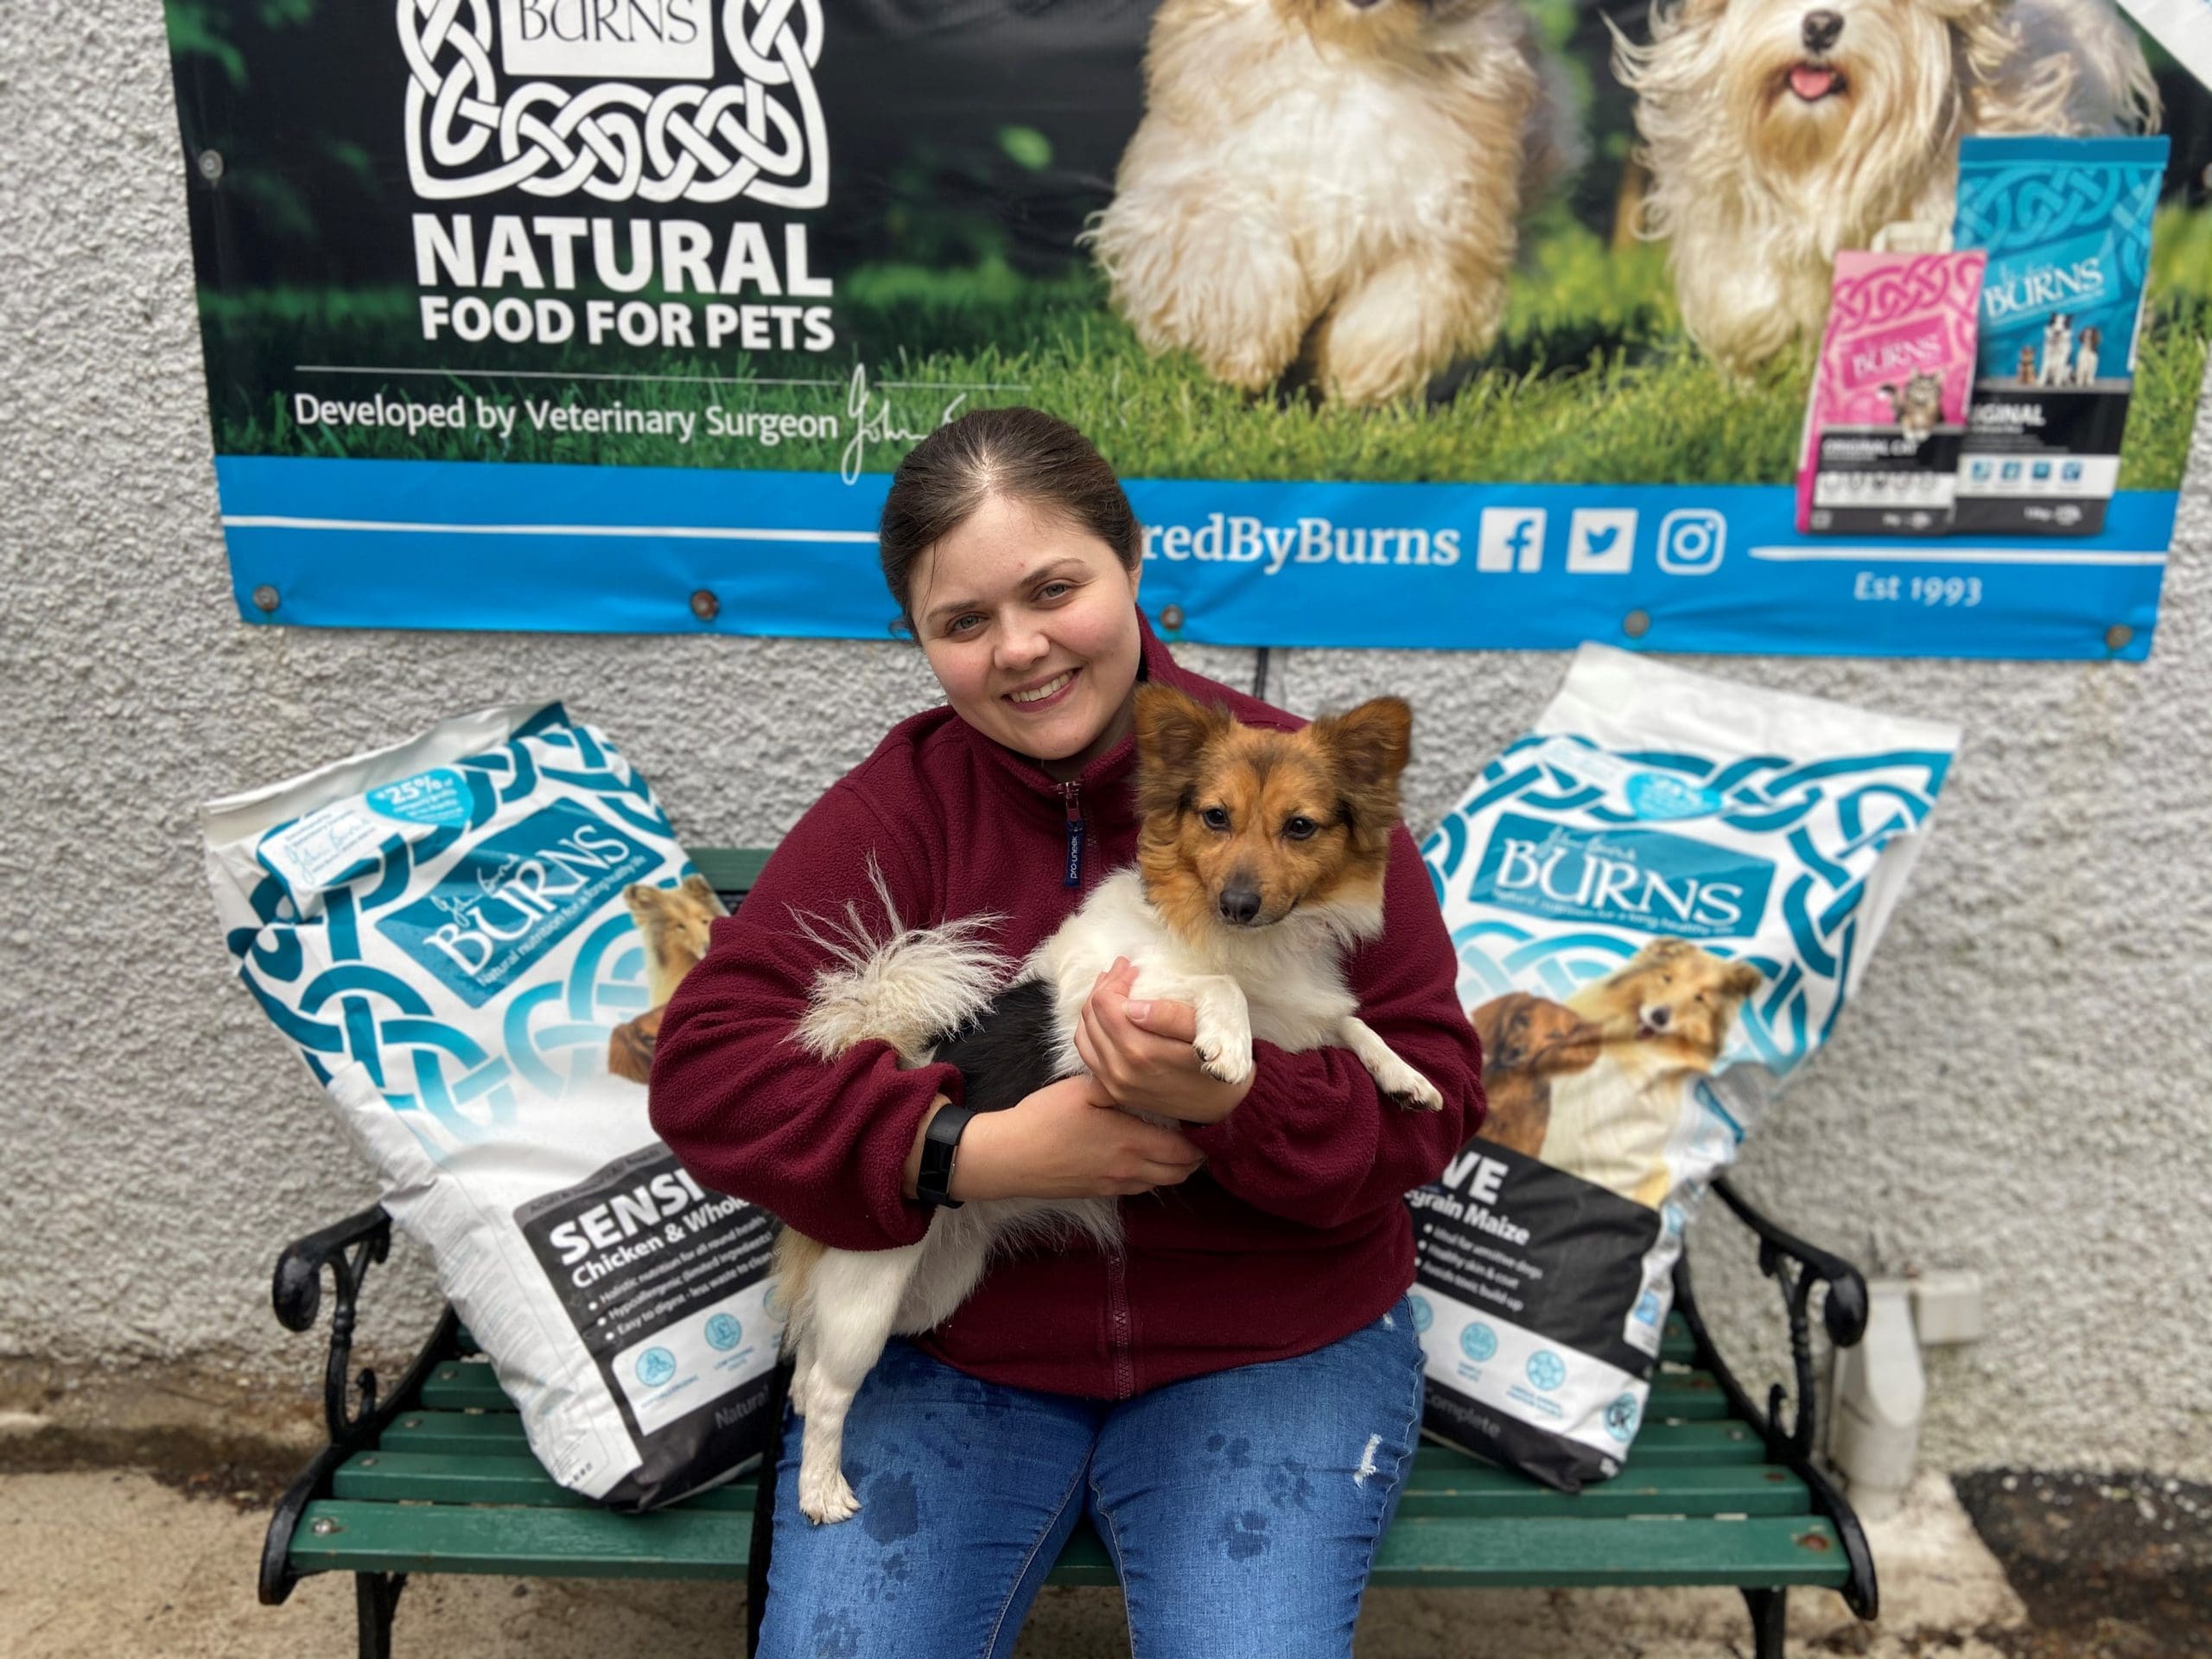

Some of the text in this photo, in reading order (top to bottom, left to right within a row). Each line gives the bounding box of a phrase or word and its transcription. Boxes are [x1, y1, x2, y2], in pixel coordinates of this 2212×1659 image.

[519, 0, 698, 43] BURNS
[411, 213, 834, 297] NATURAL
[1984, 257, 2105, 318] BURNS
[420, 296, 835, 353] FOOD FOR PETS
[1852, 334, 1942, 378] BURNS
[295, 393, 467, 432] Developed
[476, 397, 516, 439] by
[524, 399, 695, 443] Veterinary
[707, 405, 838, 448] Surgeon
[1141, 512, 1461, 575] redByBurns
[1854, 572, 1982, 606] Est 1993
[423, 824, 630, 977] BURNS
[1496, 837, 1743, 925] BURNS
[1441, 1150, 1510, 1204] VE
[550, 1169, 704, 1266] SENSI
[1465, 1204, 1531, 1246] Maize
[572, 1237, 664, 1288] Chicken
[663, 1221, 684, 1243] &
[639, 1256, 682, 1284] nutrition
[680, 1249, 696, 1262] for
[695, 1243, 708, 1255] all
[608, 1274, 683, 1319] Hypoallergenic
[618, 1316, 643, 1335] Easy
[642, 1310, 655, 1322] to
[654, 1293, 686, 1316] digest
[690, 1281, 709, 1298] less
[708, 1268, 737, 1289] waste
[736, 1262, 748, 1274] to
